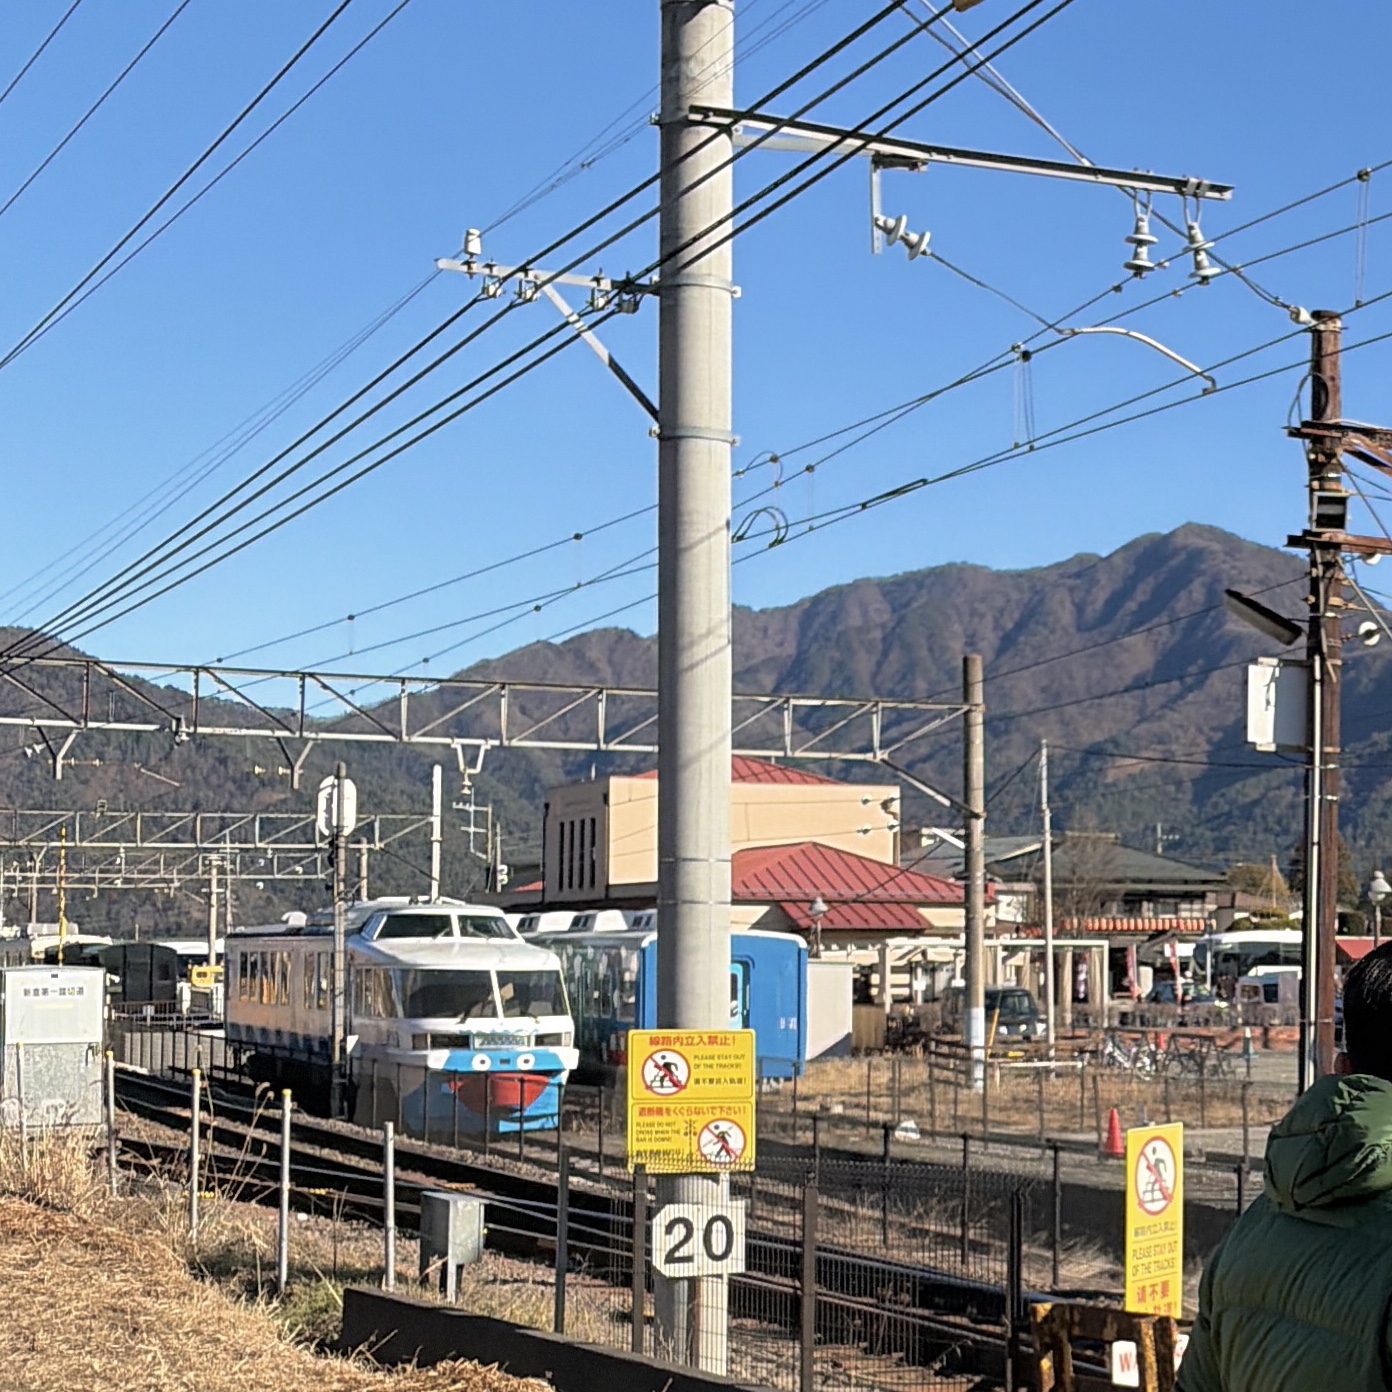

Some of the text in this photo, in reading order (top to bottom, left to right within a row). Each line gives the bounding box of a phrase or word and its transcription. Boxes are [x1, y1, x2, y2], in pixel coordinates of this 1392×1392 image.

[664, 1214, 734, 1265] 20
[1132, 1240, 1178, 1261] PLEASE STAY OUT
[1132, 1263, 1140, 1277] OF
[1141, 1261, 1152, 1274] THE
